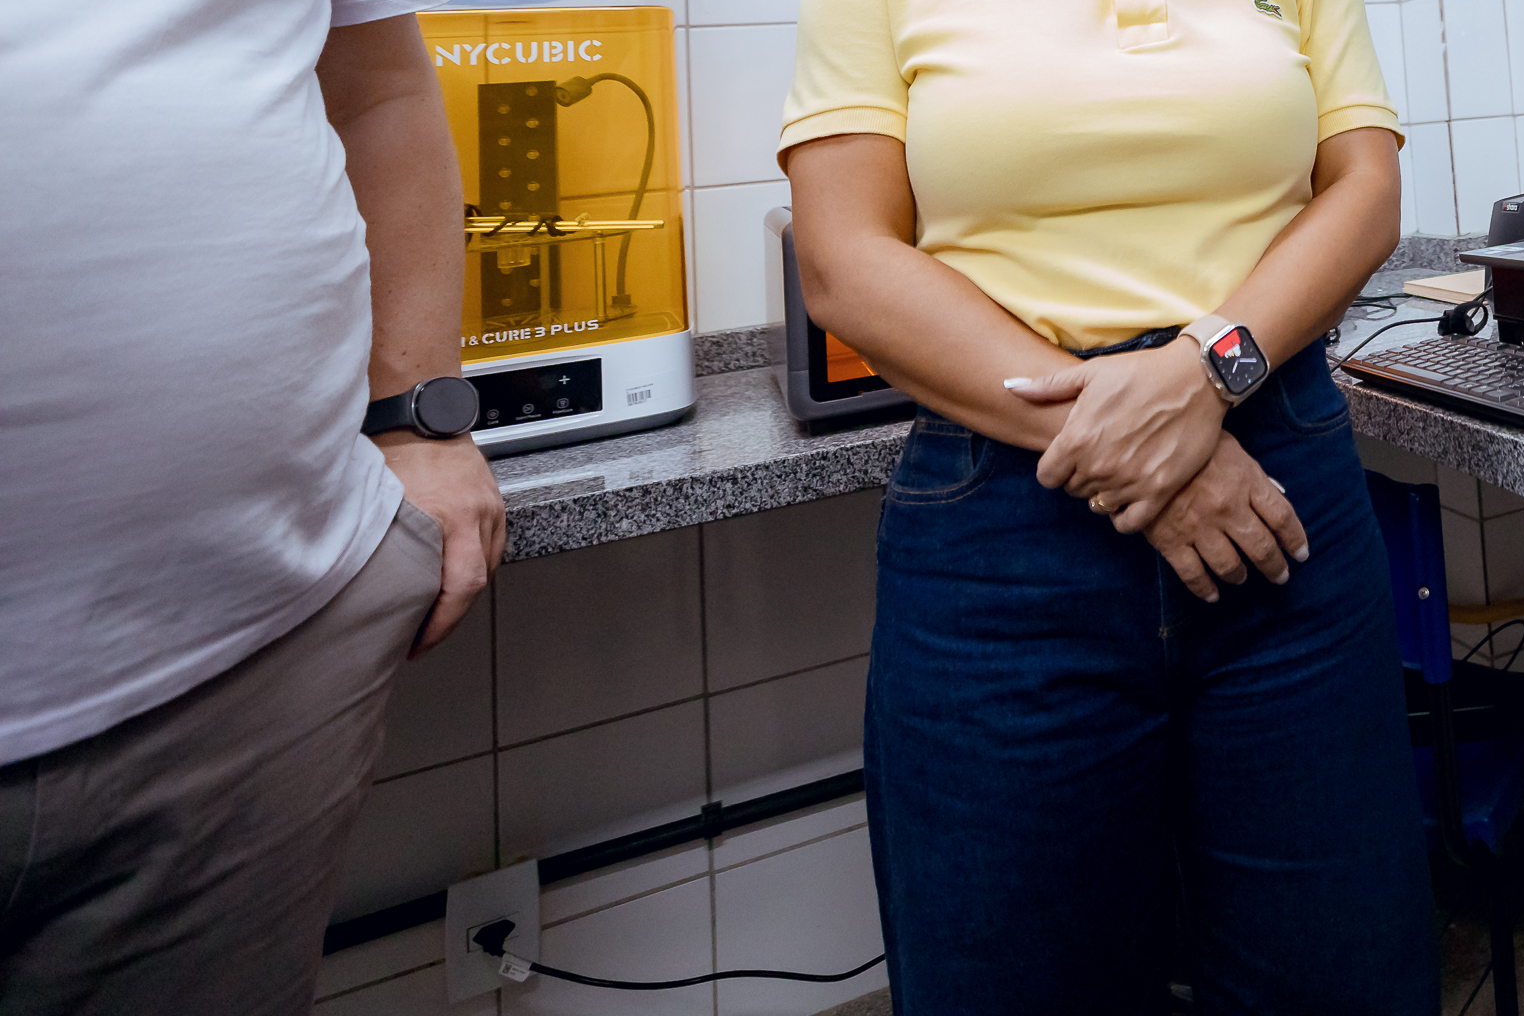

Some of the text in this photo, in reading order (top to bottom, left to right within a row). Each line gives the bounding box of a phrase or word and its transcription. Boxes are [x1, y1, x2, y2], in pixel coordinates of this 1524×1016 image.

[435, 39, 603, 67] NYCUBIC
[481, 327, 531, 345] CURE
[534, 326, 546, 338] 3
[550, 319, 599, 336] PLUS
